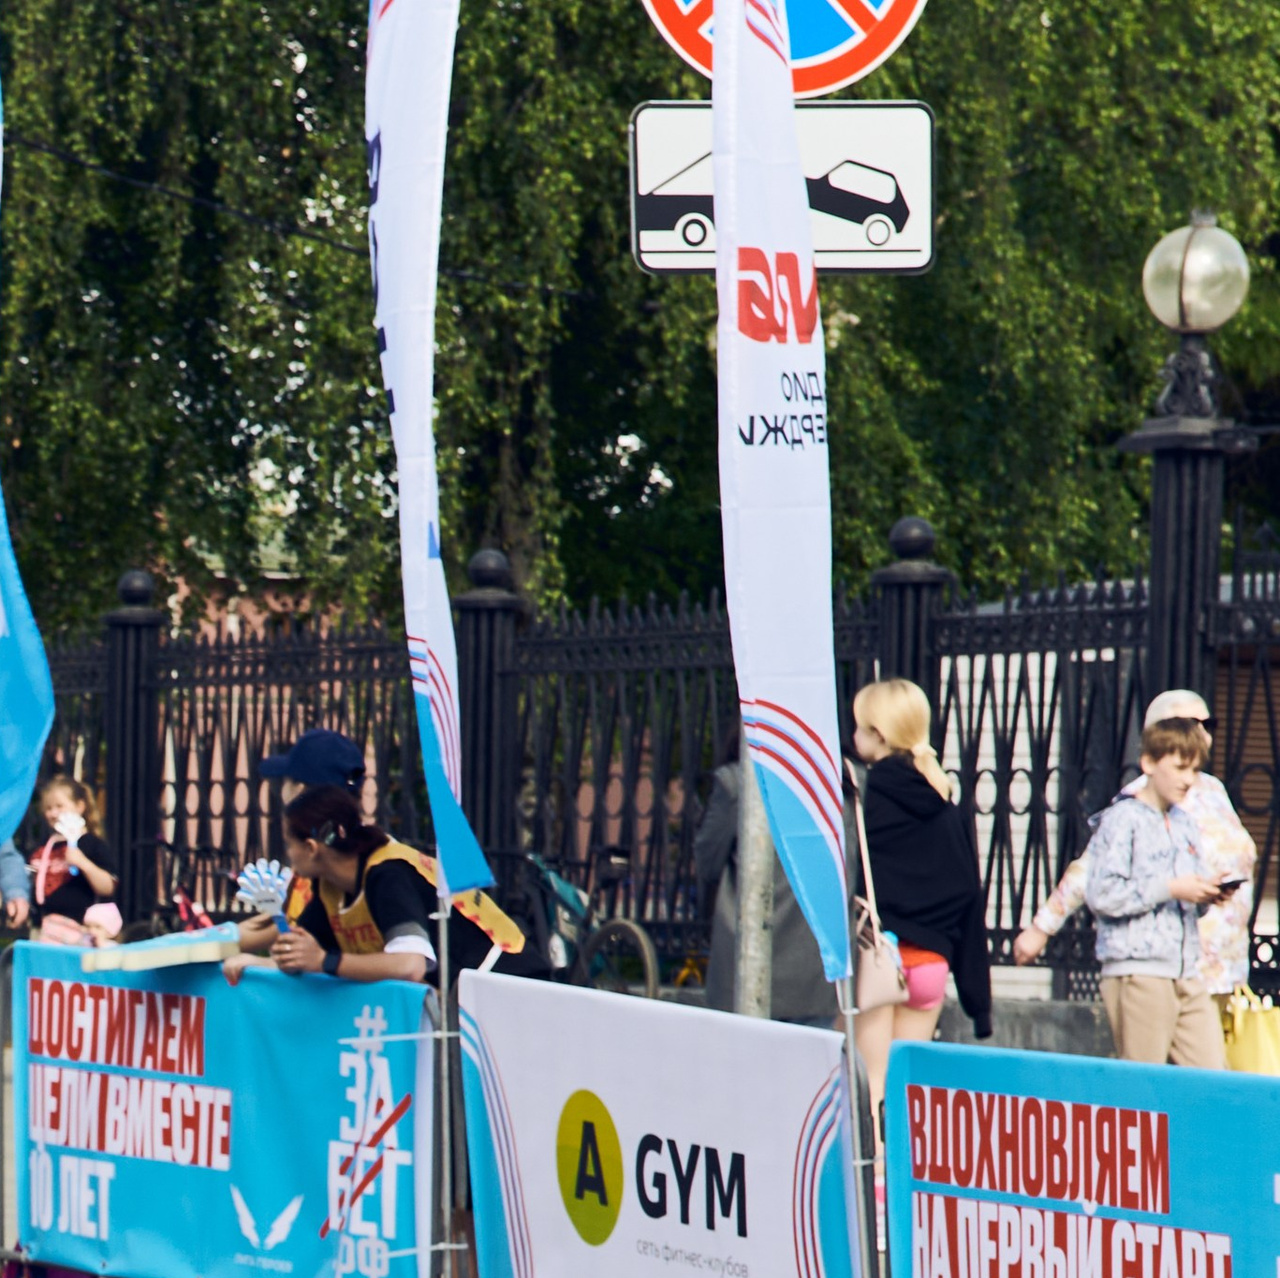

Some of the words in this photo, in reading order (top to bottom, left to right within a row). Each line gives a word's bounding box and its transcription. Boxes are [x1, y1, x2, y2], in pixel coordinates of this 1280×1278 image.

[28, 978, 206, 1077] ДОСТИГАЕМ
[28, 1063, 102, 1151] ЦЕЛИ
[104, 1074, 232, 1172] ВМЕСТЕ
[339, 1051, 399, 1151] ЗА
[906, 1083, 1170, 1215] ВДОХНОВЛЯЕМ
[57, 1154, 116, 1241] ЛЕТ
[635, 1133, 748, 1238] GYM
